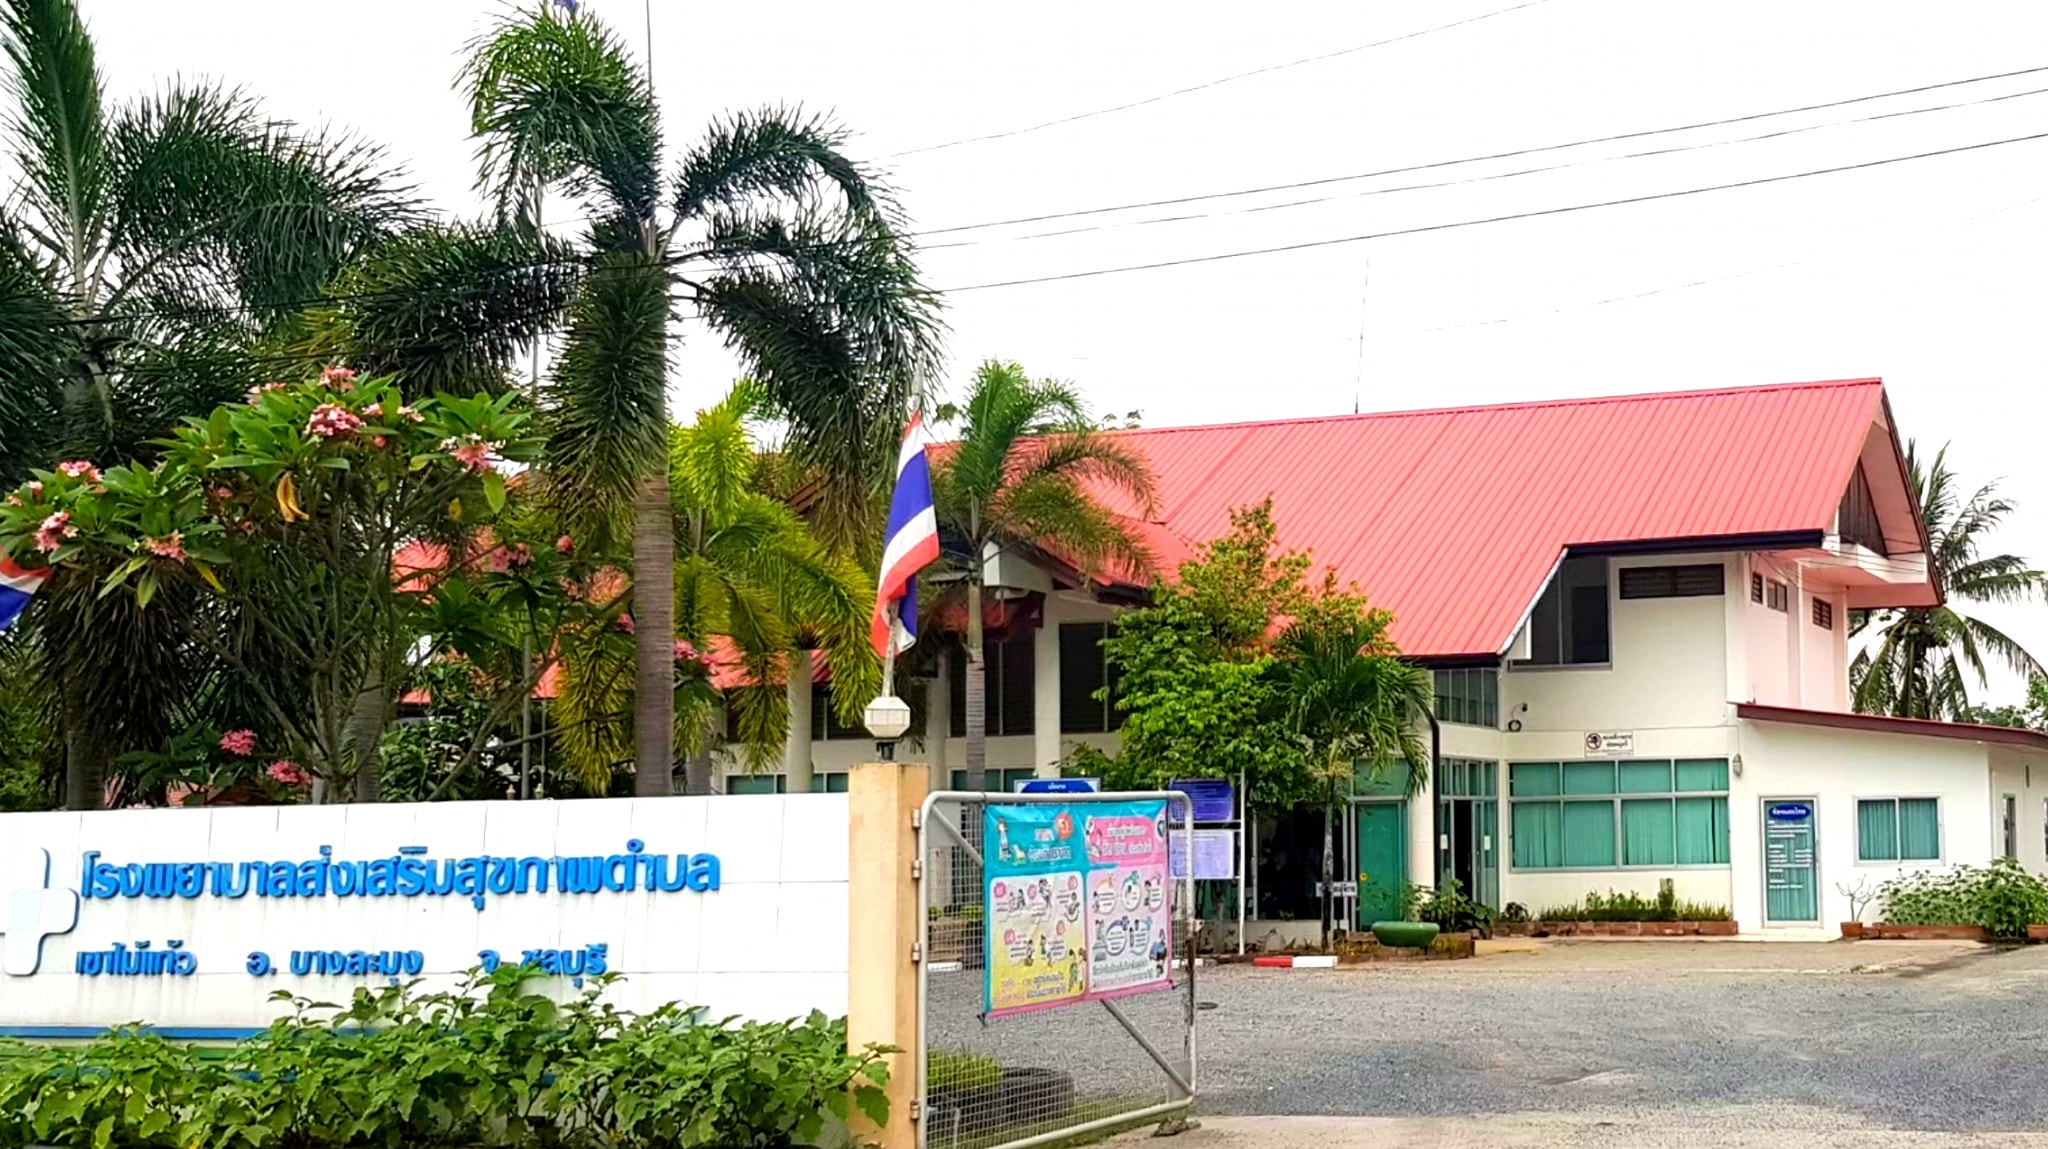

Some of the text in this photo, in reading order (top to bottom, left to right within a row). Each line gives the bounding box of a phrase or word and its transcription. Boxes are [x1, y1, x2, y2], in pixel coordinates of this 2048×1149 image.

[81, 838, 721, 911] โรงพยาบาลส่งเสริมสุขภาพตำบล
[75, 939, 198, 977] เขาไม้แก้ว
[245, 951, 278, 977] อ.
[290, 949, 425, 987] บางละมุง
[520, 941, 608, 990] ชลบุรี
